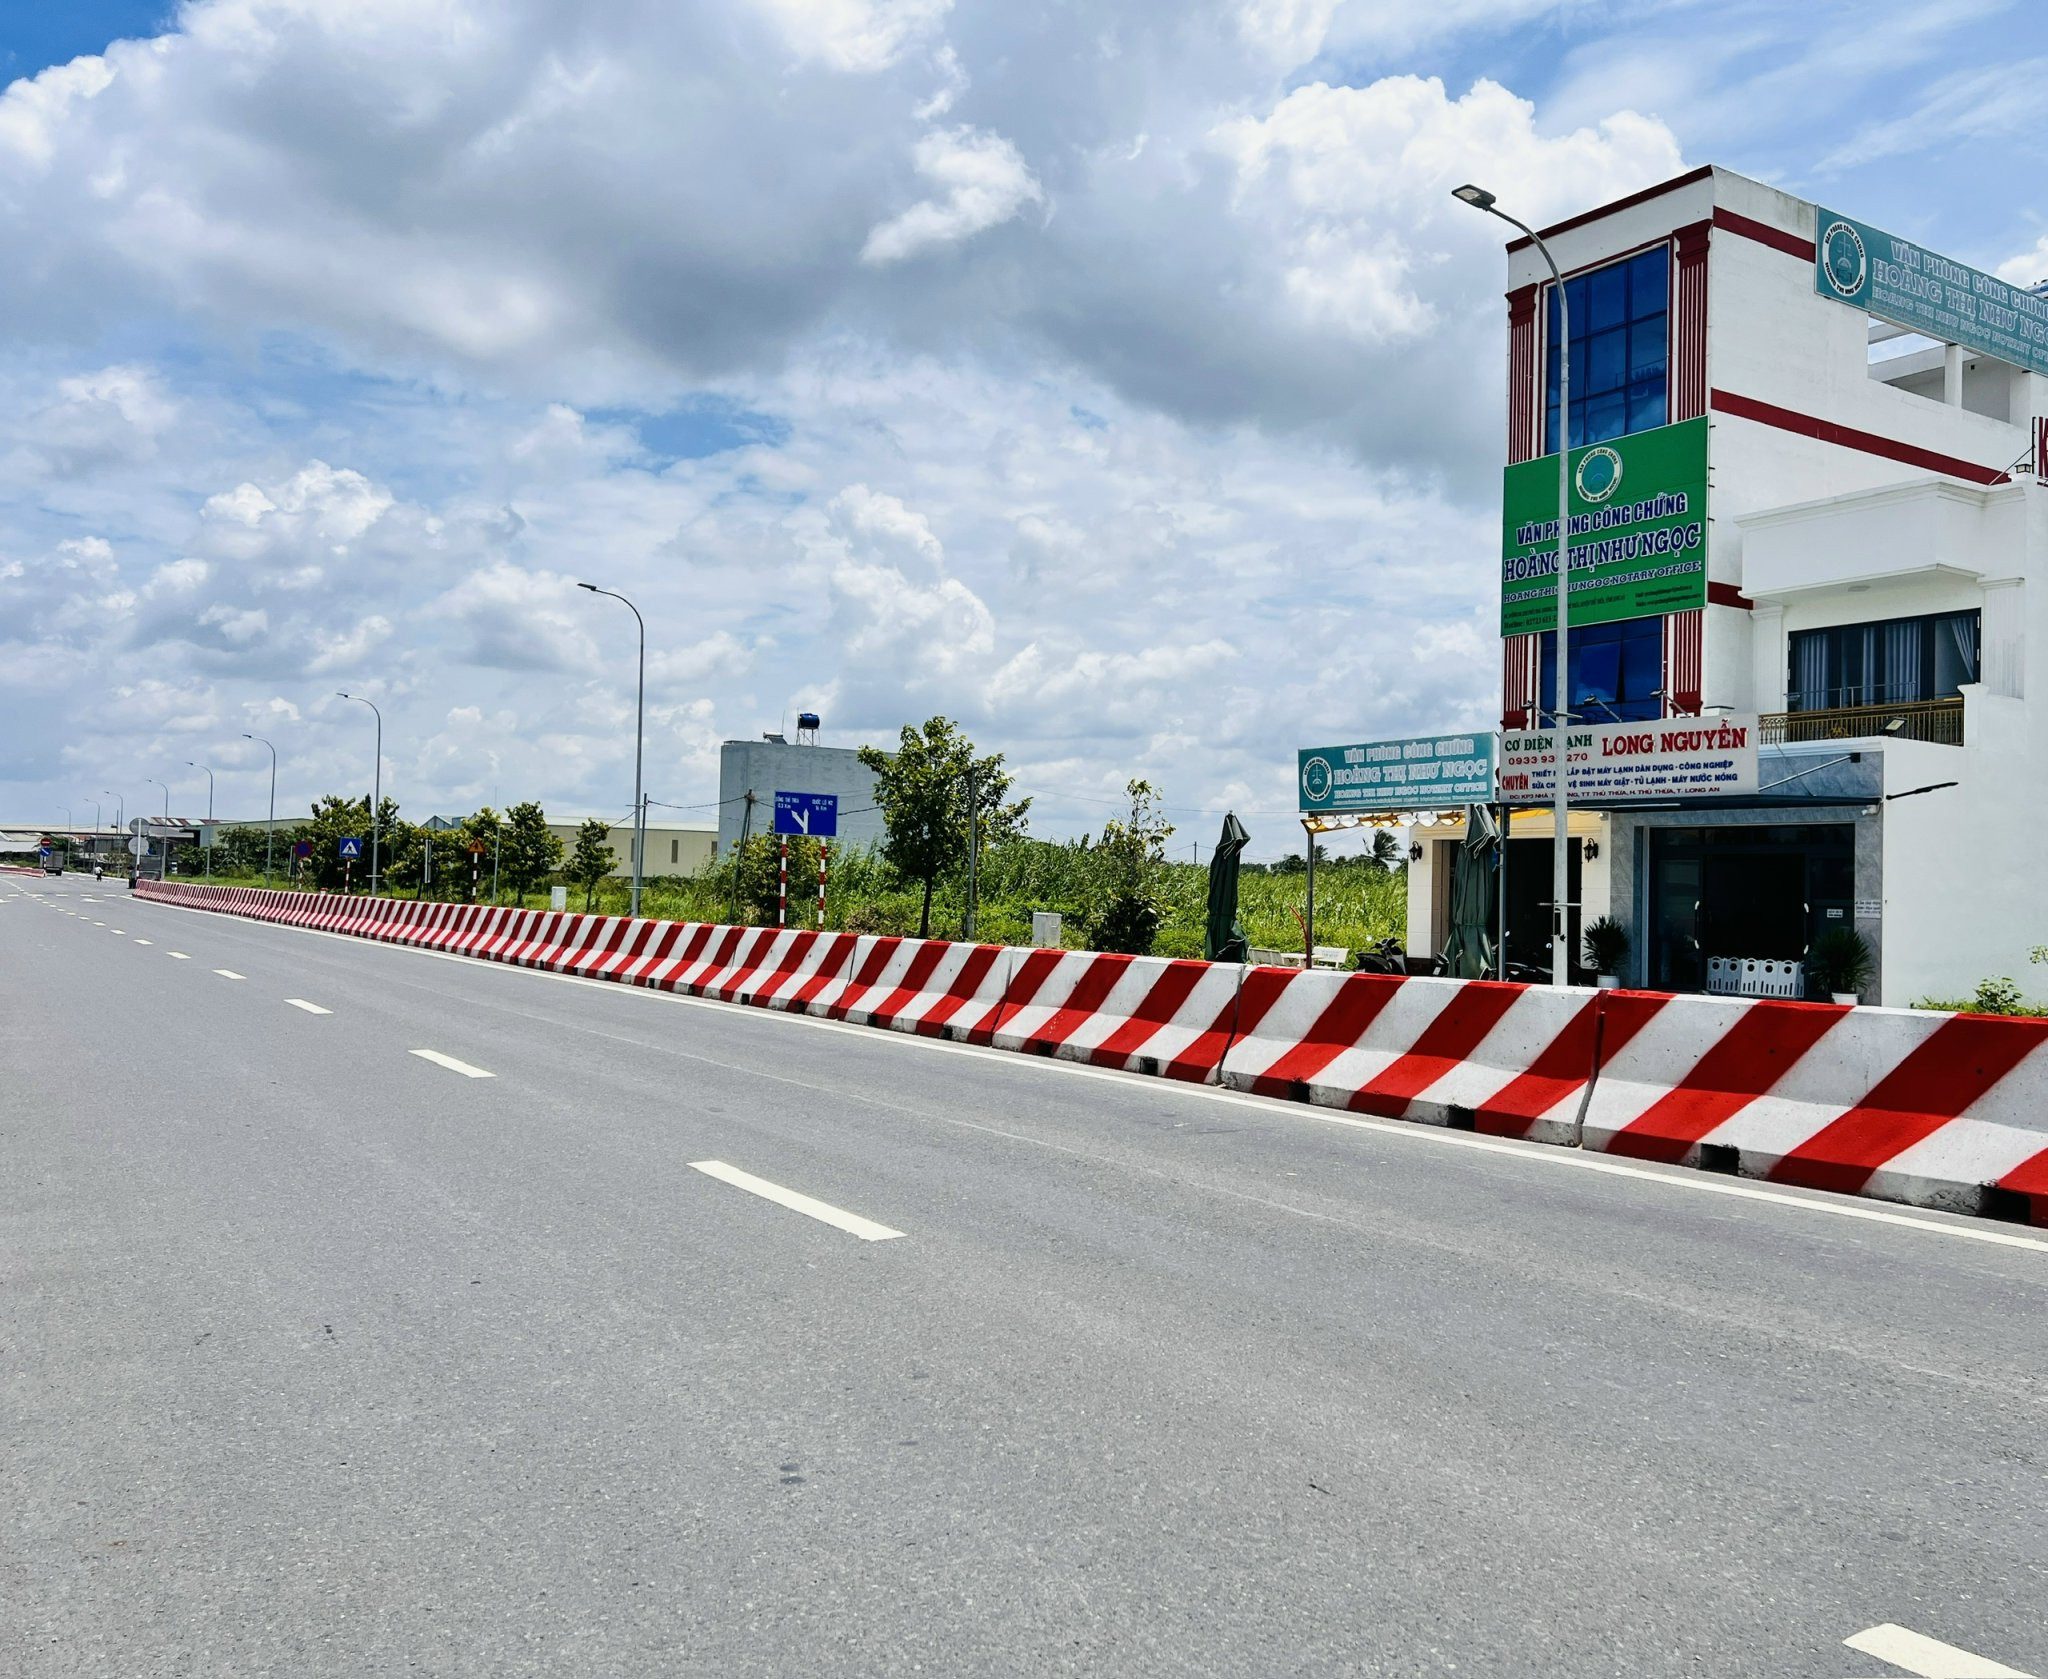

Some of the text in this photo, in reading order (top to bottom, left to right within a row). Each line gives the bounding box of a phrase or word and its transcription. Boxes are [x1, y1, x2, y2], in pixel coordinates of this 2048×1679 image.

[1890, 240, 1920, 269] VĂN
[1923, 254, 1970, 289] PHÒNG
[1973, 274, 2009, 304] CÔNG
[1873, 257, 1943, 304] HOÀNG
[1945, 285, 1977, 321] THỊ
[1979, 299, 2018, 332] NHƯ
[1516, 491, 1688, 546] VĂN PHNG CÔNG CHỨNG
[1567, 543, 1597, 573] THỊ
[1596, 531, 1642, 565] NHƯ
[1640, 522, 1701, 558] NGỌC
[1503, 589, 1538, 603] HOANG
[1538, 586, 1556, 597] THI
[1579, 576, 1612, 591] NGOC
[1611, 569, 1657, 586] NOTARY
[1656, 560, 1702, 577] OFFICE
[1504, 734, 1593, 753] CƠ ĐIỆN ẠNH
[1602, 718, 1747, 757] LONG NGUYỄN
[1333, 764, 1382, 786] HOÀNG
[1407, 760, 1442, 781] NHƯ
[1442, 758, 1488, 781] NGỌC
[1508, 756, 1538, 766] 0933
[1566, 752, 1588, 762] 270
[1531, 769, 1552, 778] THIẾT
[1613, 766, 1634, 775] LẠNH
[1679, 761, 1702, 770] CÔNG
[1703, 759, 1734, 770] NGHIỆP
[1502, 772, 1529, 791] CHUYÊN
[1646, 776, 1667, 786] LẠNH
[1714, 772, 1738, 782] NÓNG
